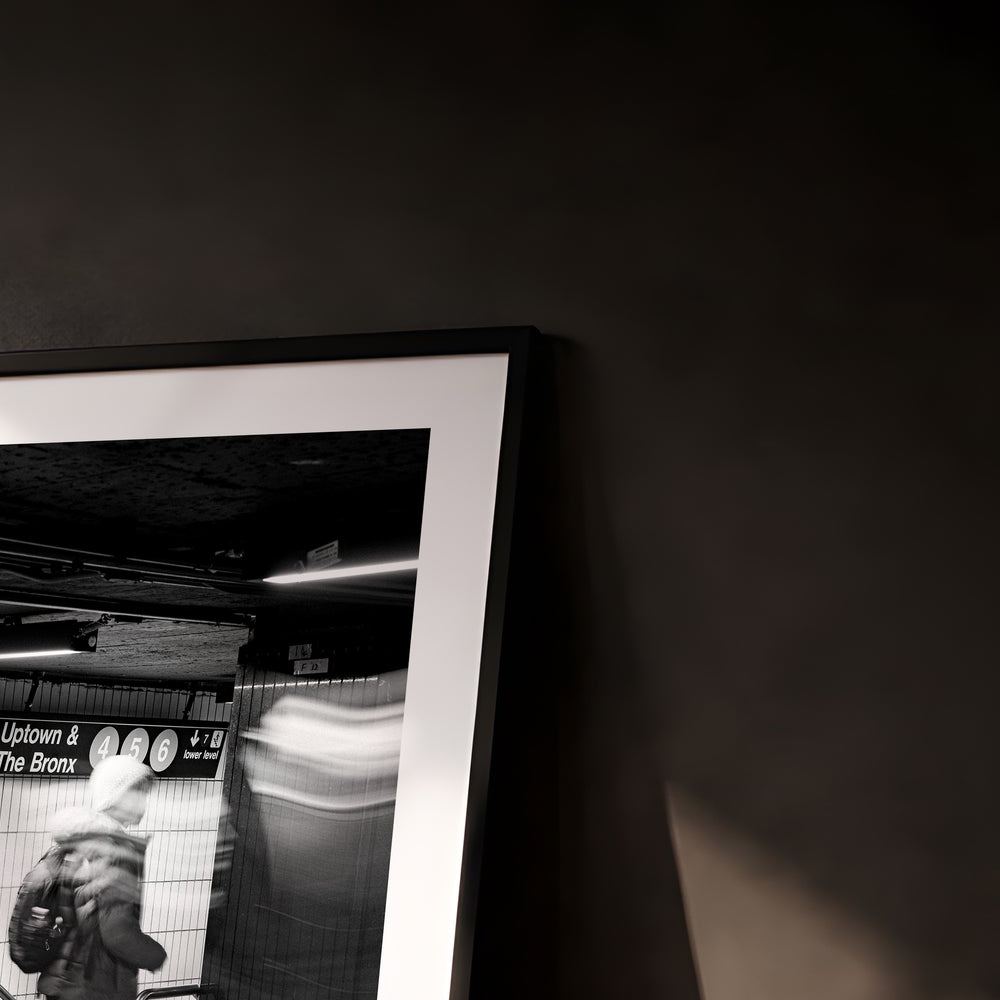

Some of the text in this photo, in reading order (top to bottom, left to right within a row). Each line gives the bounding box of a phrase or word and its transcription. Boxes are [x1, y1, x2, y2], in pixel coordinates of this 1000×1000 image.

[1, 721, 79, 747] Uptown &
[203, 734, 210, 744] 7
[97, 735, 171, 762] 4 5 6
[183, 750, 219, 760] lower level
[29, 751, 77, 773] Bronx
